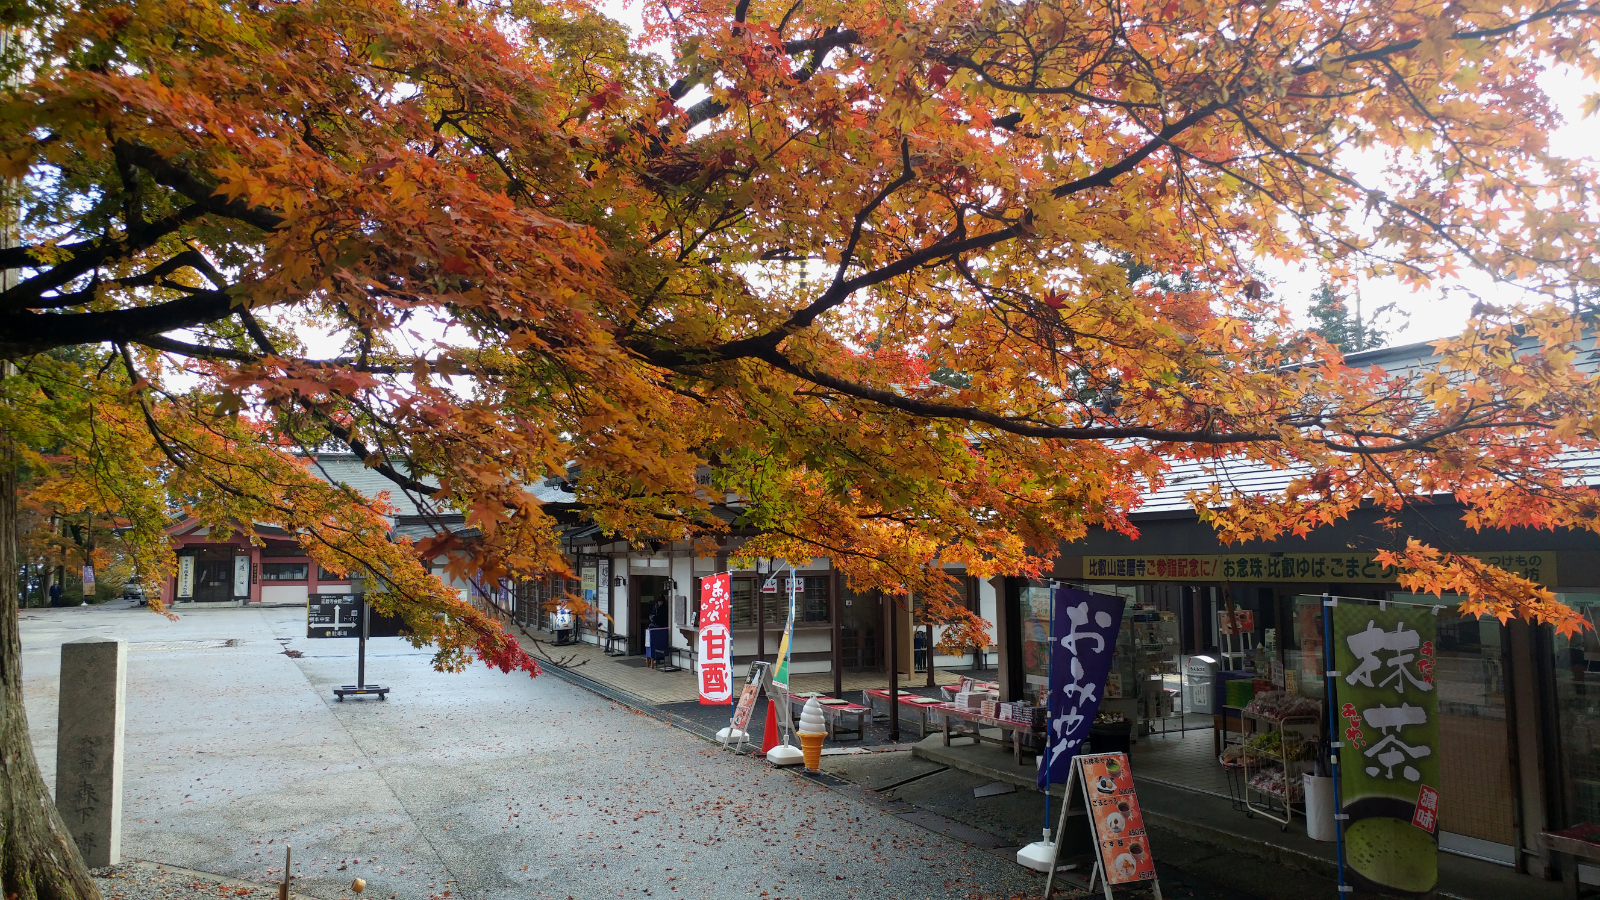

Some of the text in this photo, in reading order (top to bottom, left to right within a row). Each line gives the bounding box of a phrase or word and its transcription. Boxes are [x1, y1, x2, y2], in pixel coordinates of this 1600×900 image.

[1488, 555, 1541, 566] つけもの
[1345, 619, 1434, 782] 抹茶
[1416, 788, 1437, 828] 濃味
